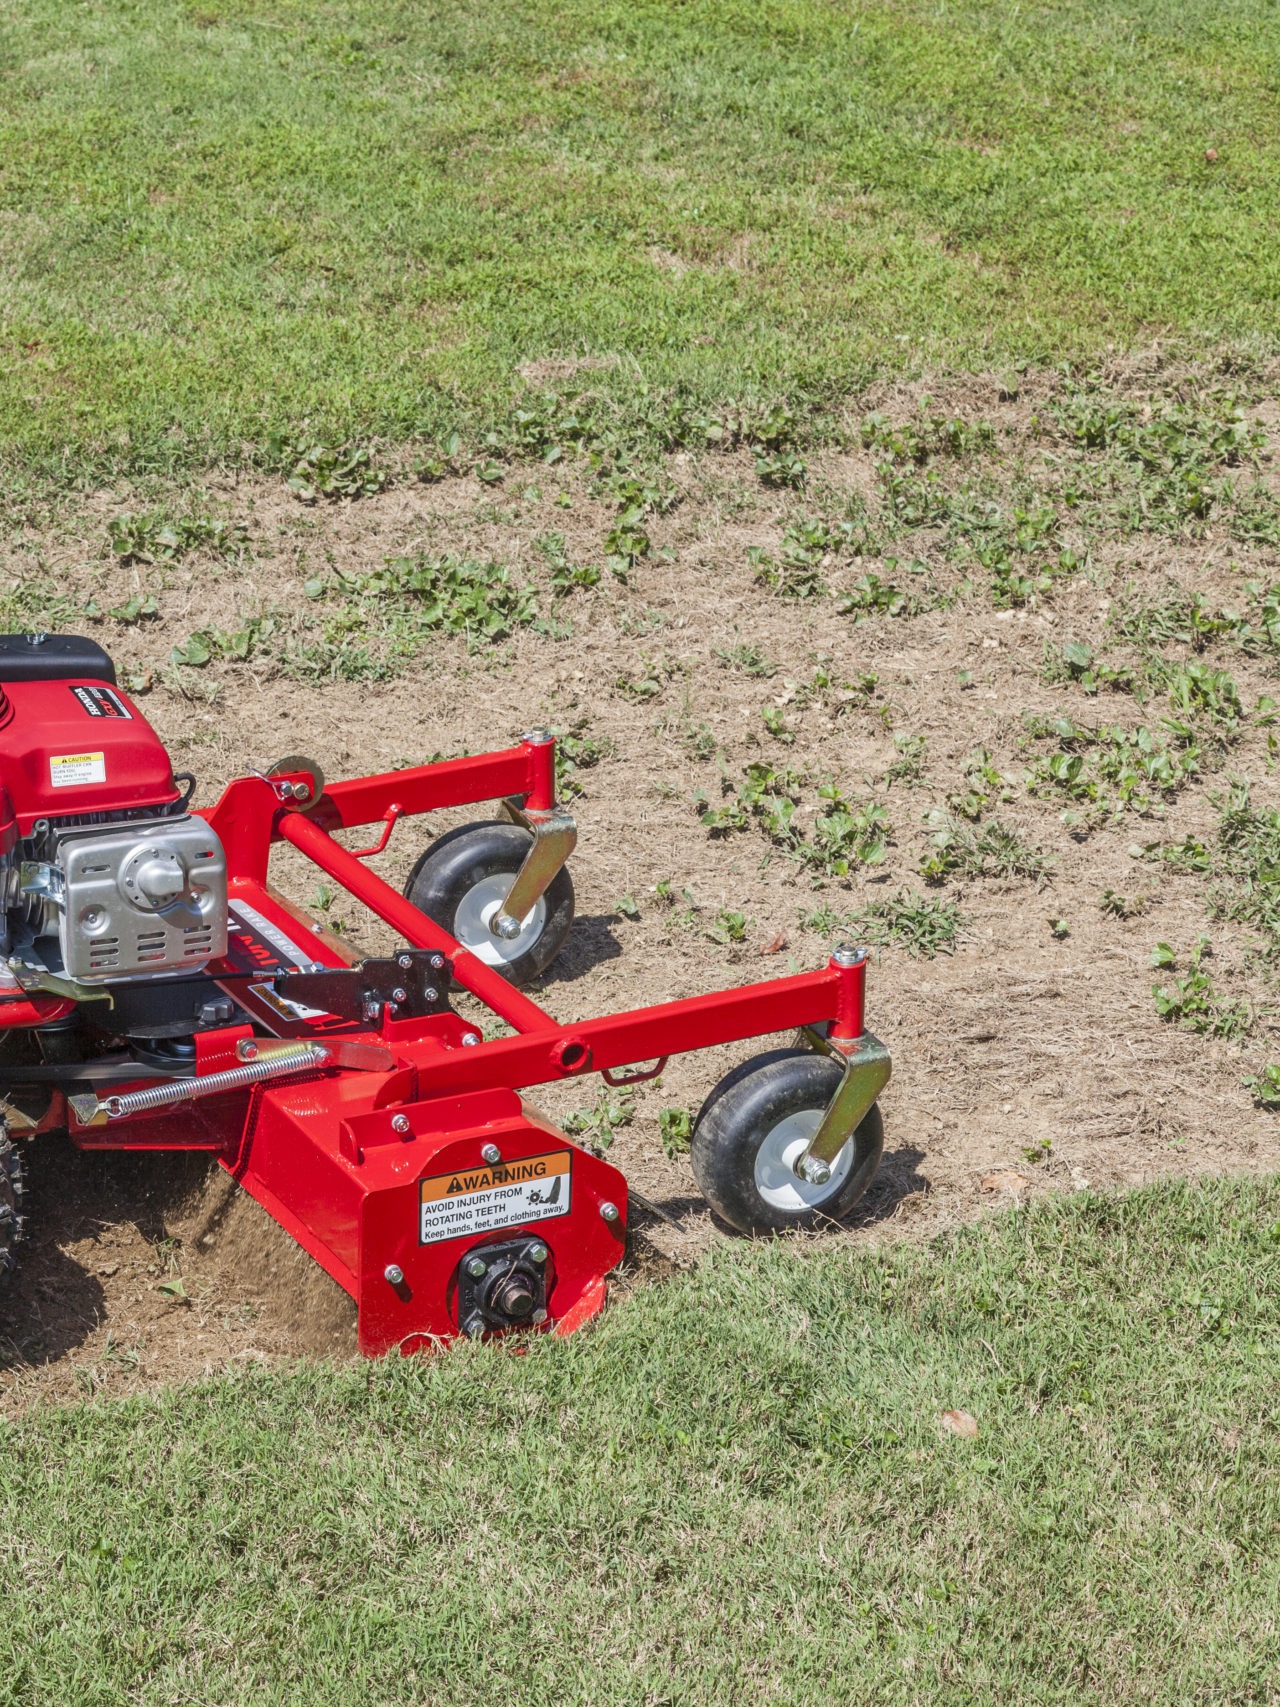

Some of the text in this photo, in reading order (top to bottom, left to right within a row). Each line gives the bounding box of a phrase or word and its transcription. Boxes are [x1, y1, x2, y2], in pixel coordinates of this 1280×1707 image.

[74, 687, 102, 716] HONDA
[239, 906, 266, 928] RAKE
[265, 929, 301, 957] POWER
[463, 1161, 547, 1191] WARNING
[425, 1187, 523, 1216] AVOID INJURY FROM
[425, 1203, 506, 1228] ROTATING TEETH
[424, 1204, 565, 1240] Keep hands, feet, and clothing away.
